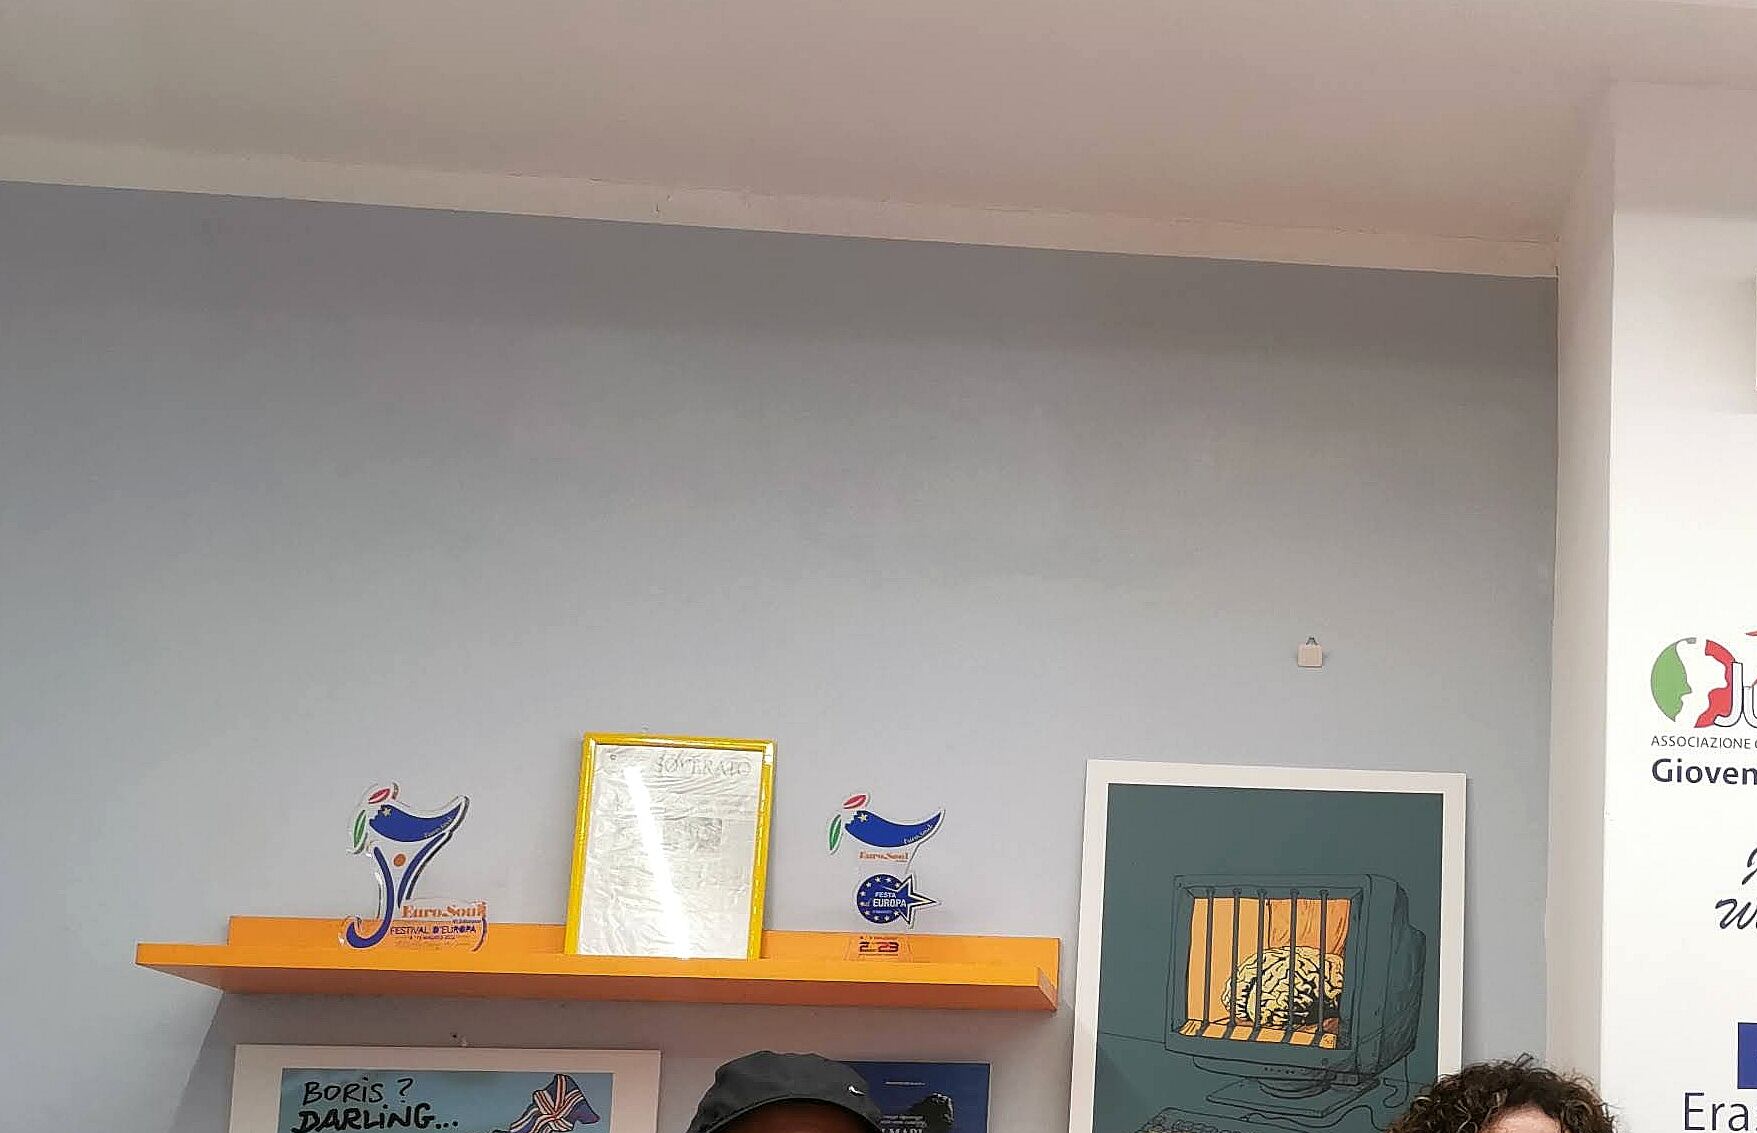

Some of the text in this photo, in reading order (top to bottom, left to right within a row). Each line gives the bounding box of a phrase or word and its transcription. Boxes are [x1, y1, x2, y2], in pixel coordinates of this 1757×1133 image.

[1650, 736, 1751, 750] ASSOCIAZIONE
[872, 898, 907, 908] EUROPA
[390, 926, 429, 935] FESTIVAL
